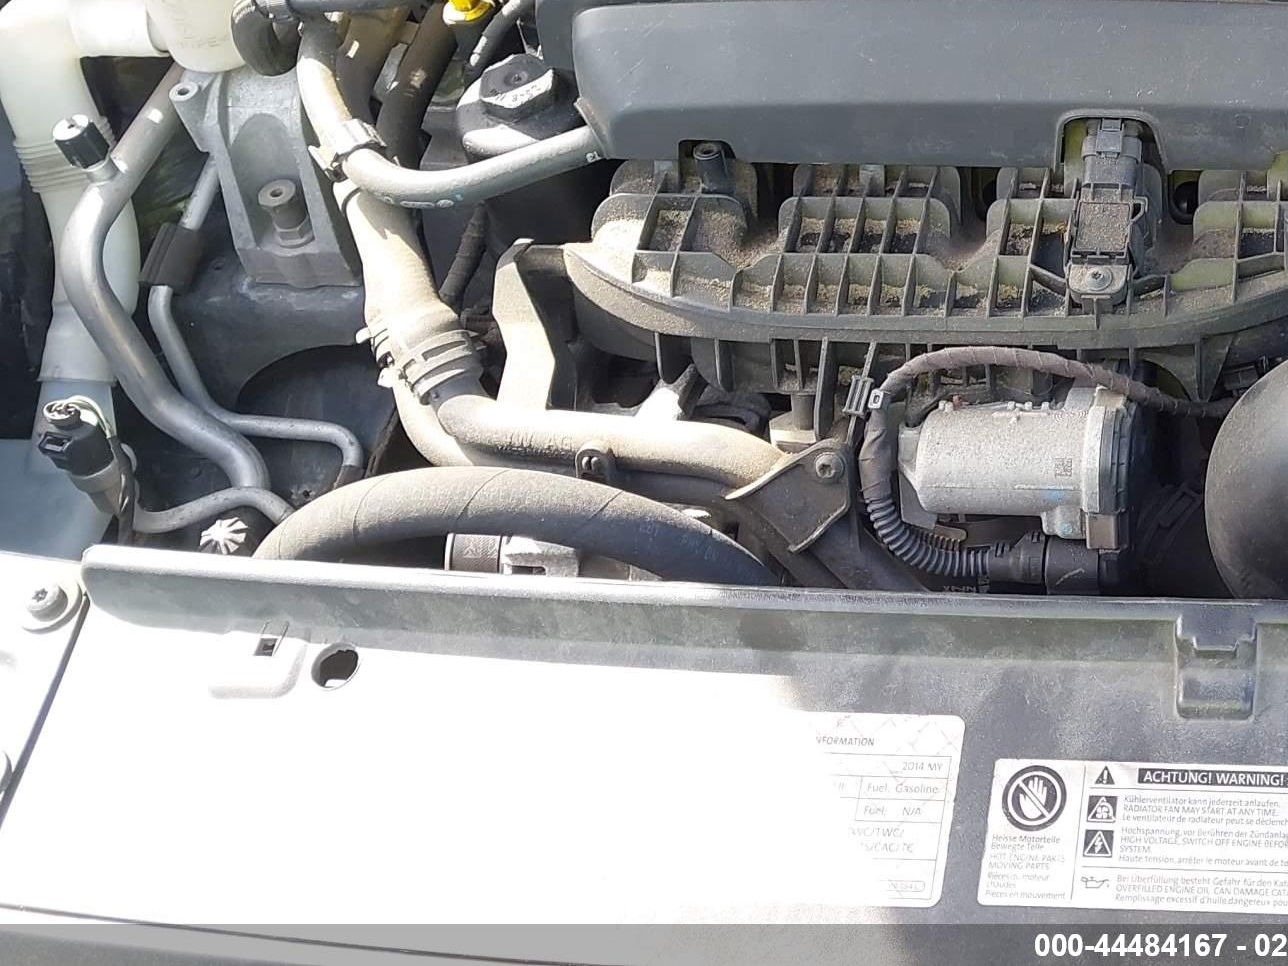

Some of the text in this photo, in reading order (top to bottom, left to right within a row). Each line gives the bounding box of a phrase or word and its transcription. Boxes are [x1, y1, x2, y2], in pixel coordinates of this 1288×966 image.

[902, 761, 943, 771] 2014 MY
[1143, 771, 1212, 784] ACHTUNG!
[1216, 772, 1284, 786] WARNING!
[895, 784, 939, 794] Gasoline
[1124, 796, 1187, 805] Kühlerventilator
[1208, 799, 1243, 808] jederzeit
[902, 807, 921, 816] N/A
[1124, 805, 1163, 813] RADIATOR
[1202, 807, 1225, 815] START
[1132, 814, 1175, 823] ventilateur
[1188, 816, 1222, 824] radiateur
[1224, 817, 1244, 826] peut
[992, 834, 1017, 843] Heisse
[1121, 836, 1141, 844] HIGH
[1182, 838, 1213, 846] SWITCH
[1232, 839, 1262, 847] ENGINE
[991, 842, 1025, 852] Bewegte
[1119, 854, 1143, 863] Haute
[1214, 858, 1244, 866] moteur
[1181, 876, 1210, 885] besteht
[1213, 877, 1241, 886] Gefahr
[1244, 878, 1254, 886] für
[1256, 878, 1271, 886] den
[1116, 884, 1162, 893] OVERFILLED
[1164, 885, 1193, 894] ENGINE
[1214, 887, 1231, 895] CAN
[1233, 887, 1269, 896] DAMAGE
[1115, 894, 1164, 904] Remplissage
[1167, 895, 1197, 904] excessif
[1228, 897, 1271, 907] dangereux
